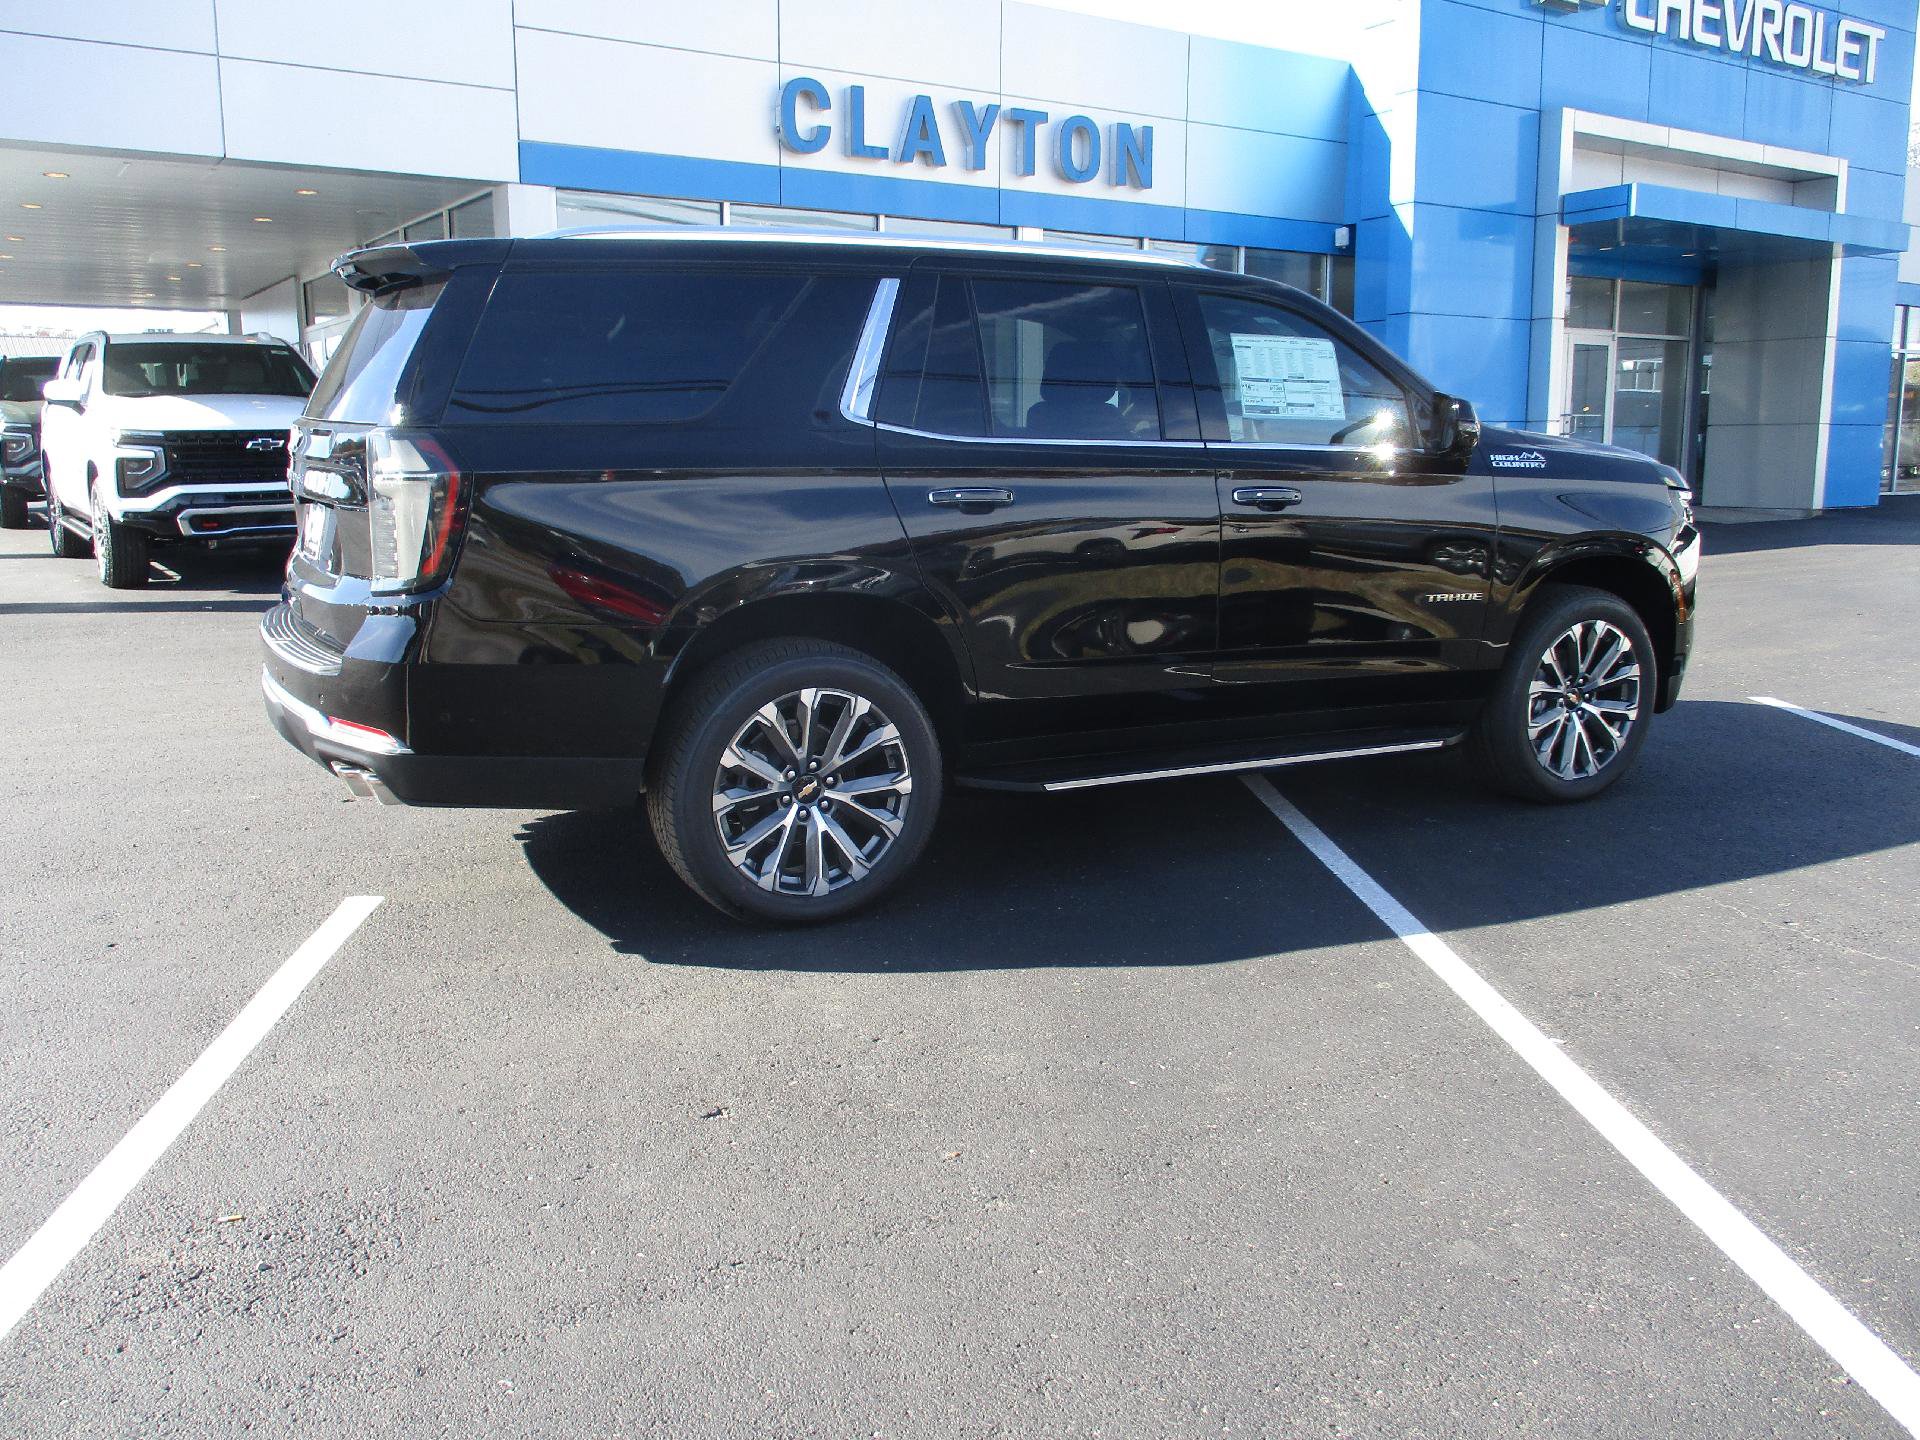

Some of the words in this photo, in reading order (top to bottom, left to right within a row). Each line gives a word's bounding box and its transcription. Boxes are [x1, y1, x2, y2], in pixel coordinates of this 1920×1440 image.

[779, 77, 1154, 189] CLAYTON
[1491, 460, 1547, 469] COUNTRY
[1425, 592, 1484, 603] TAHOE
